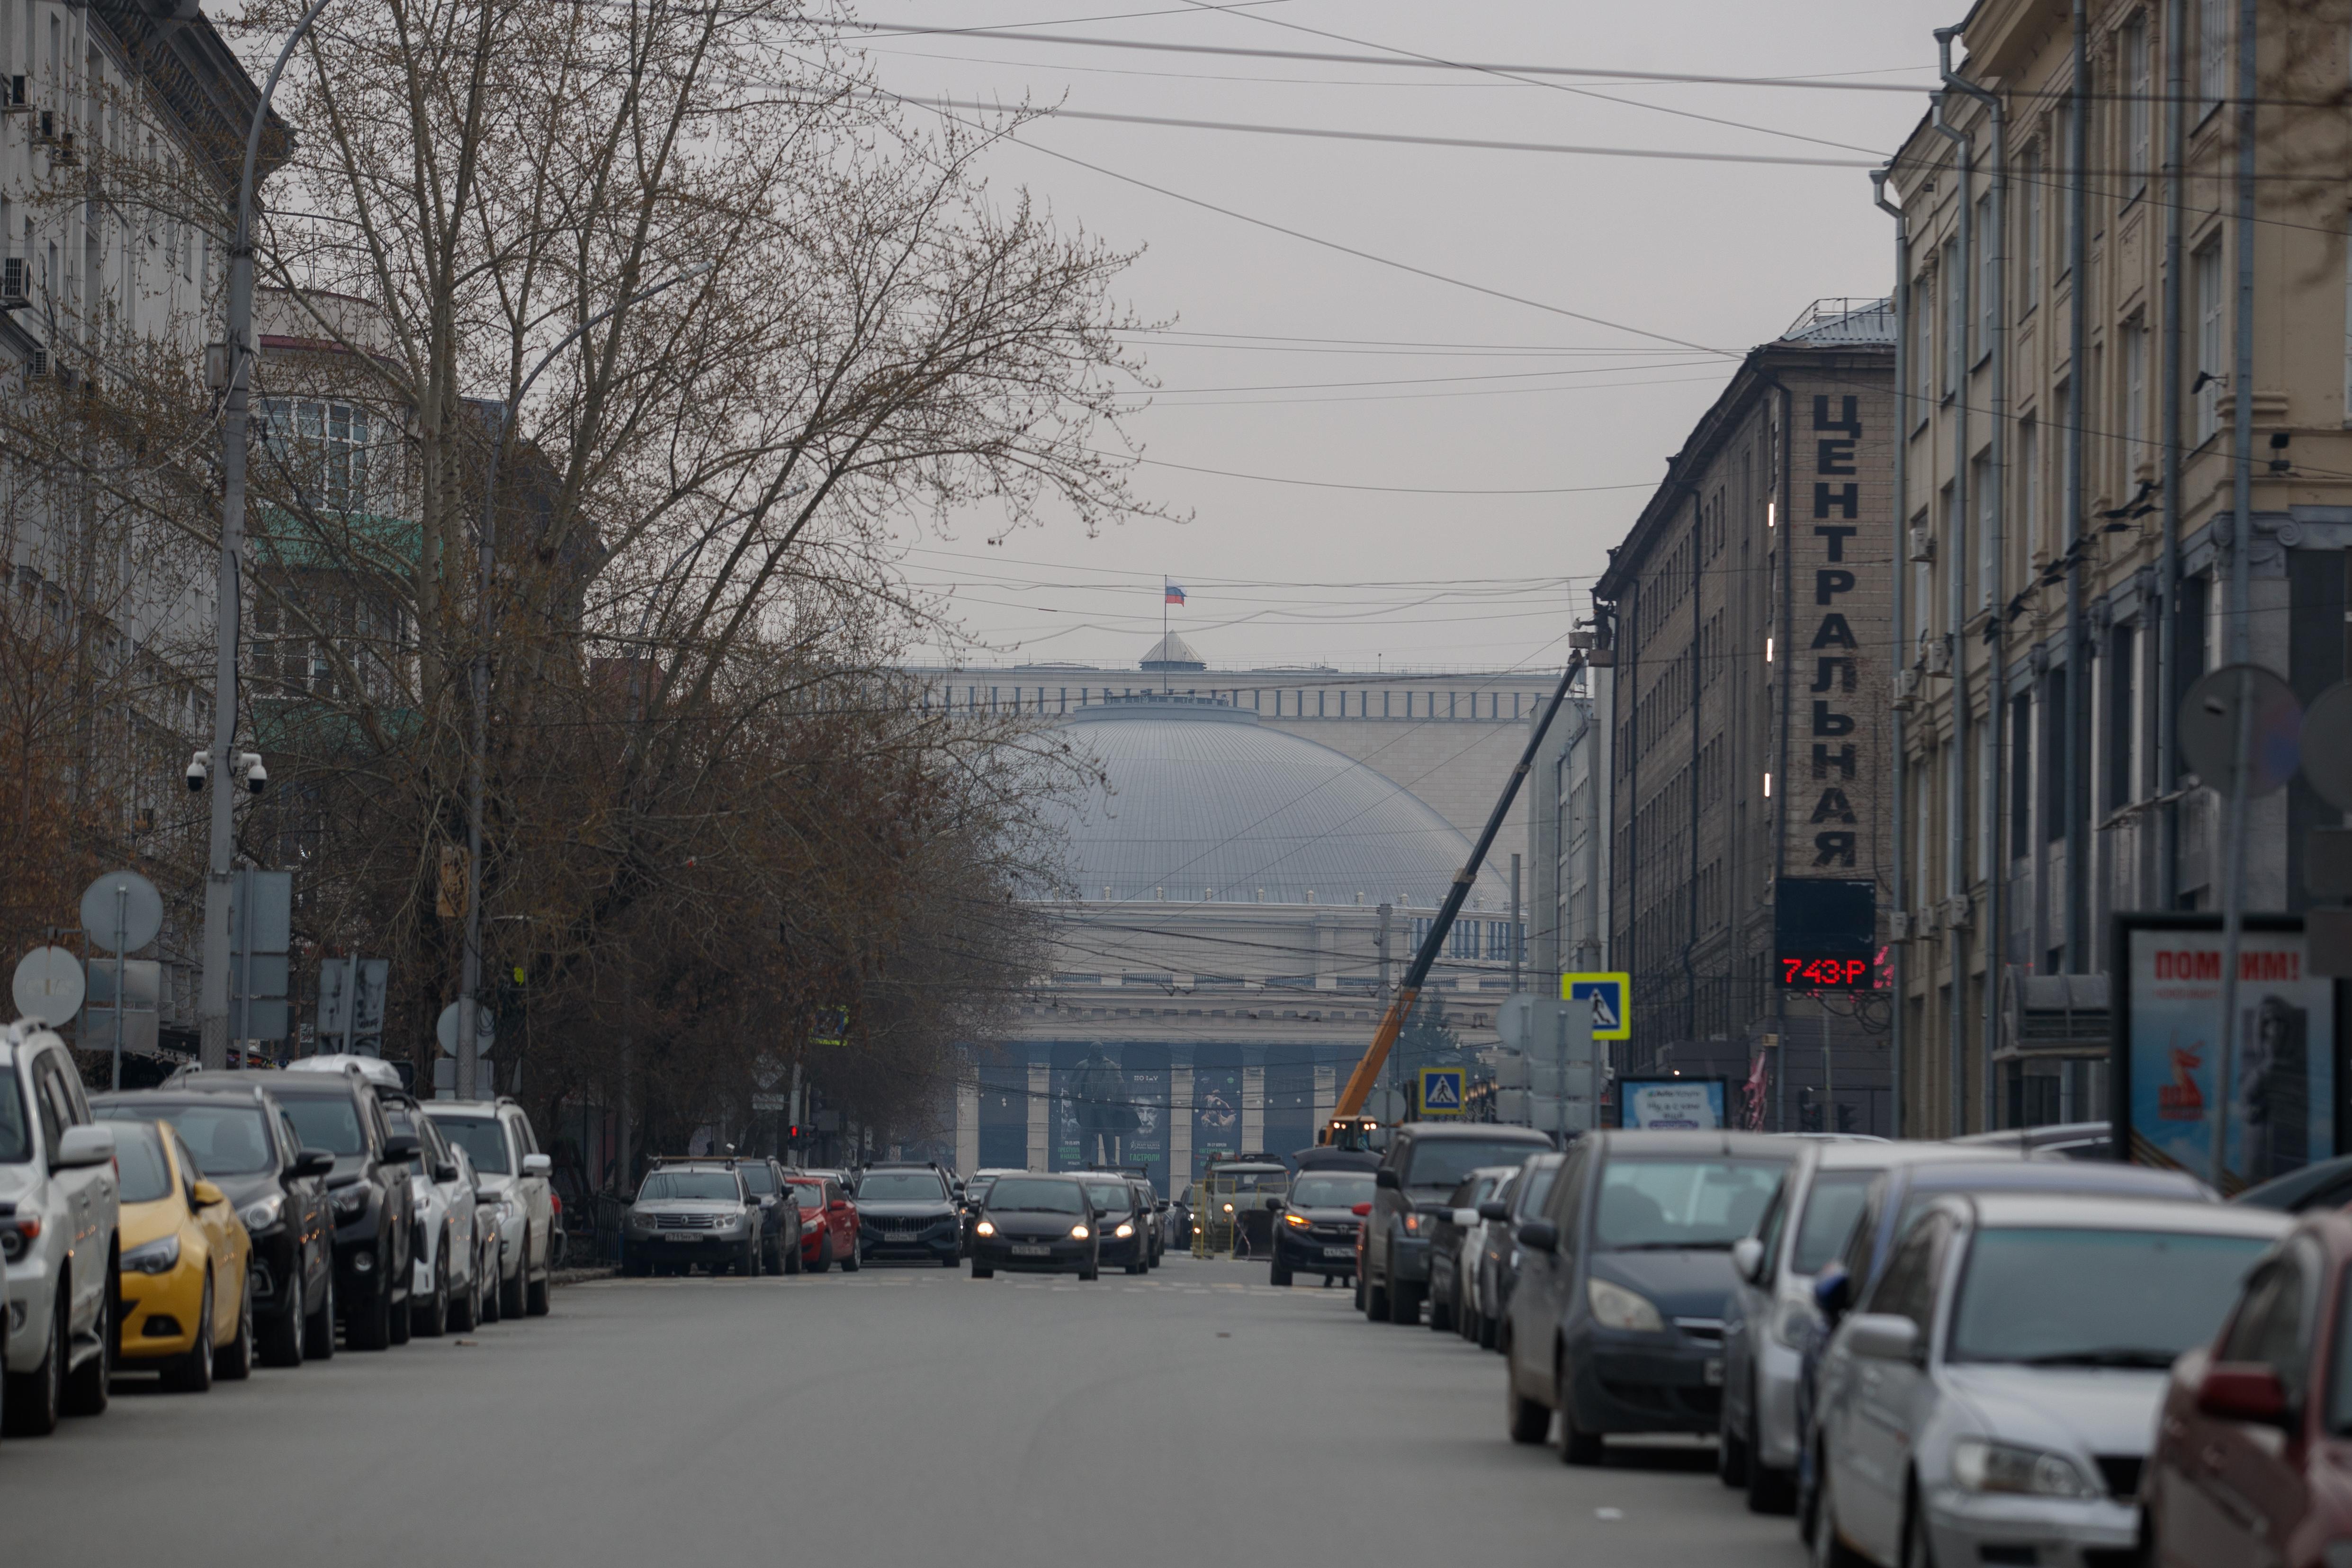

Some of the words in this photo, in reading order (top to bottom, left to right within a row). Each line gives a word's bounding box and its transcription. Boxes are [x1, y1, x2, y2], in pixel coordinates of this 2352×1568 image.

[1810, 394, 1861, 868] ЦЕНТРАЛЬНАЯ
[2155, 950, 2300, 980] ПОМИМ!
[1130, 1154, 1160, 1162] ГАСТРОЛИ
